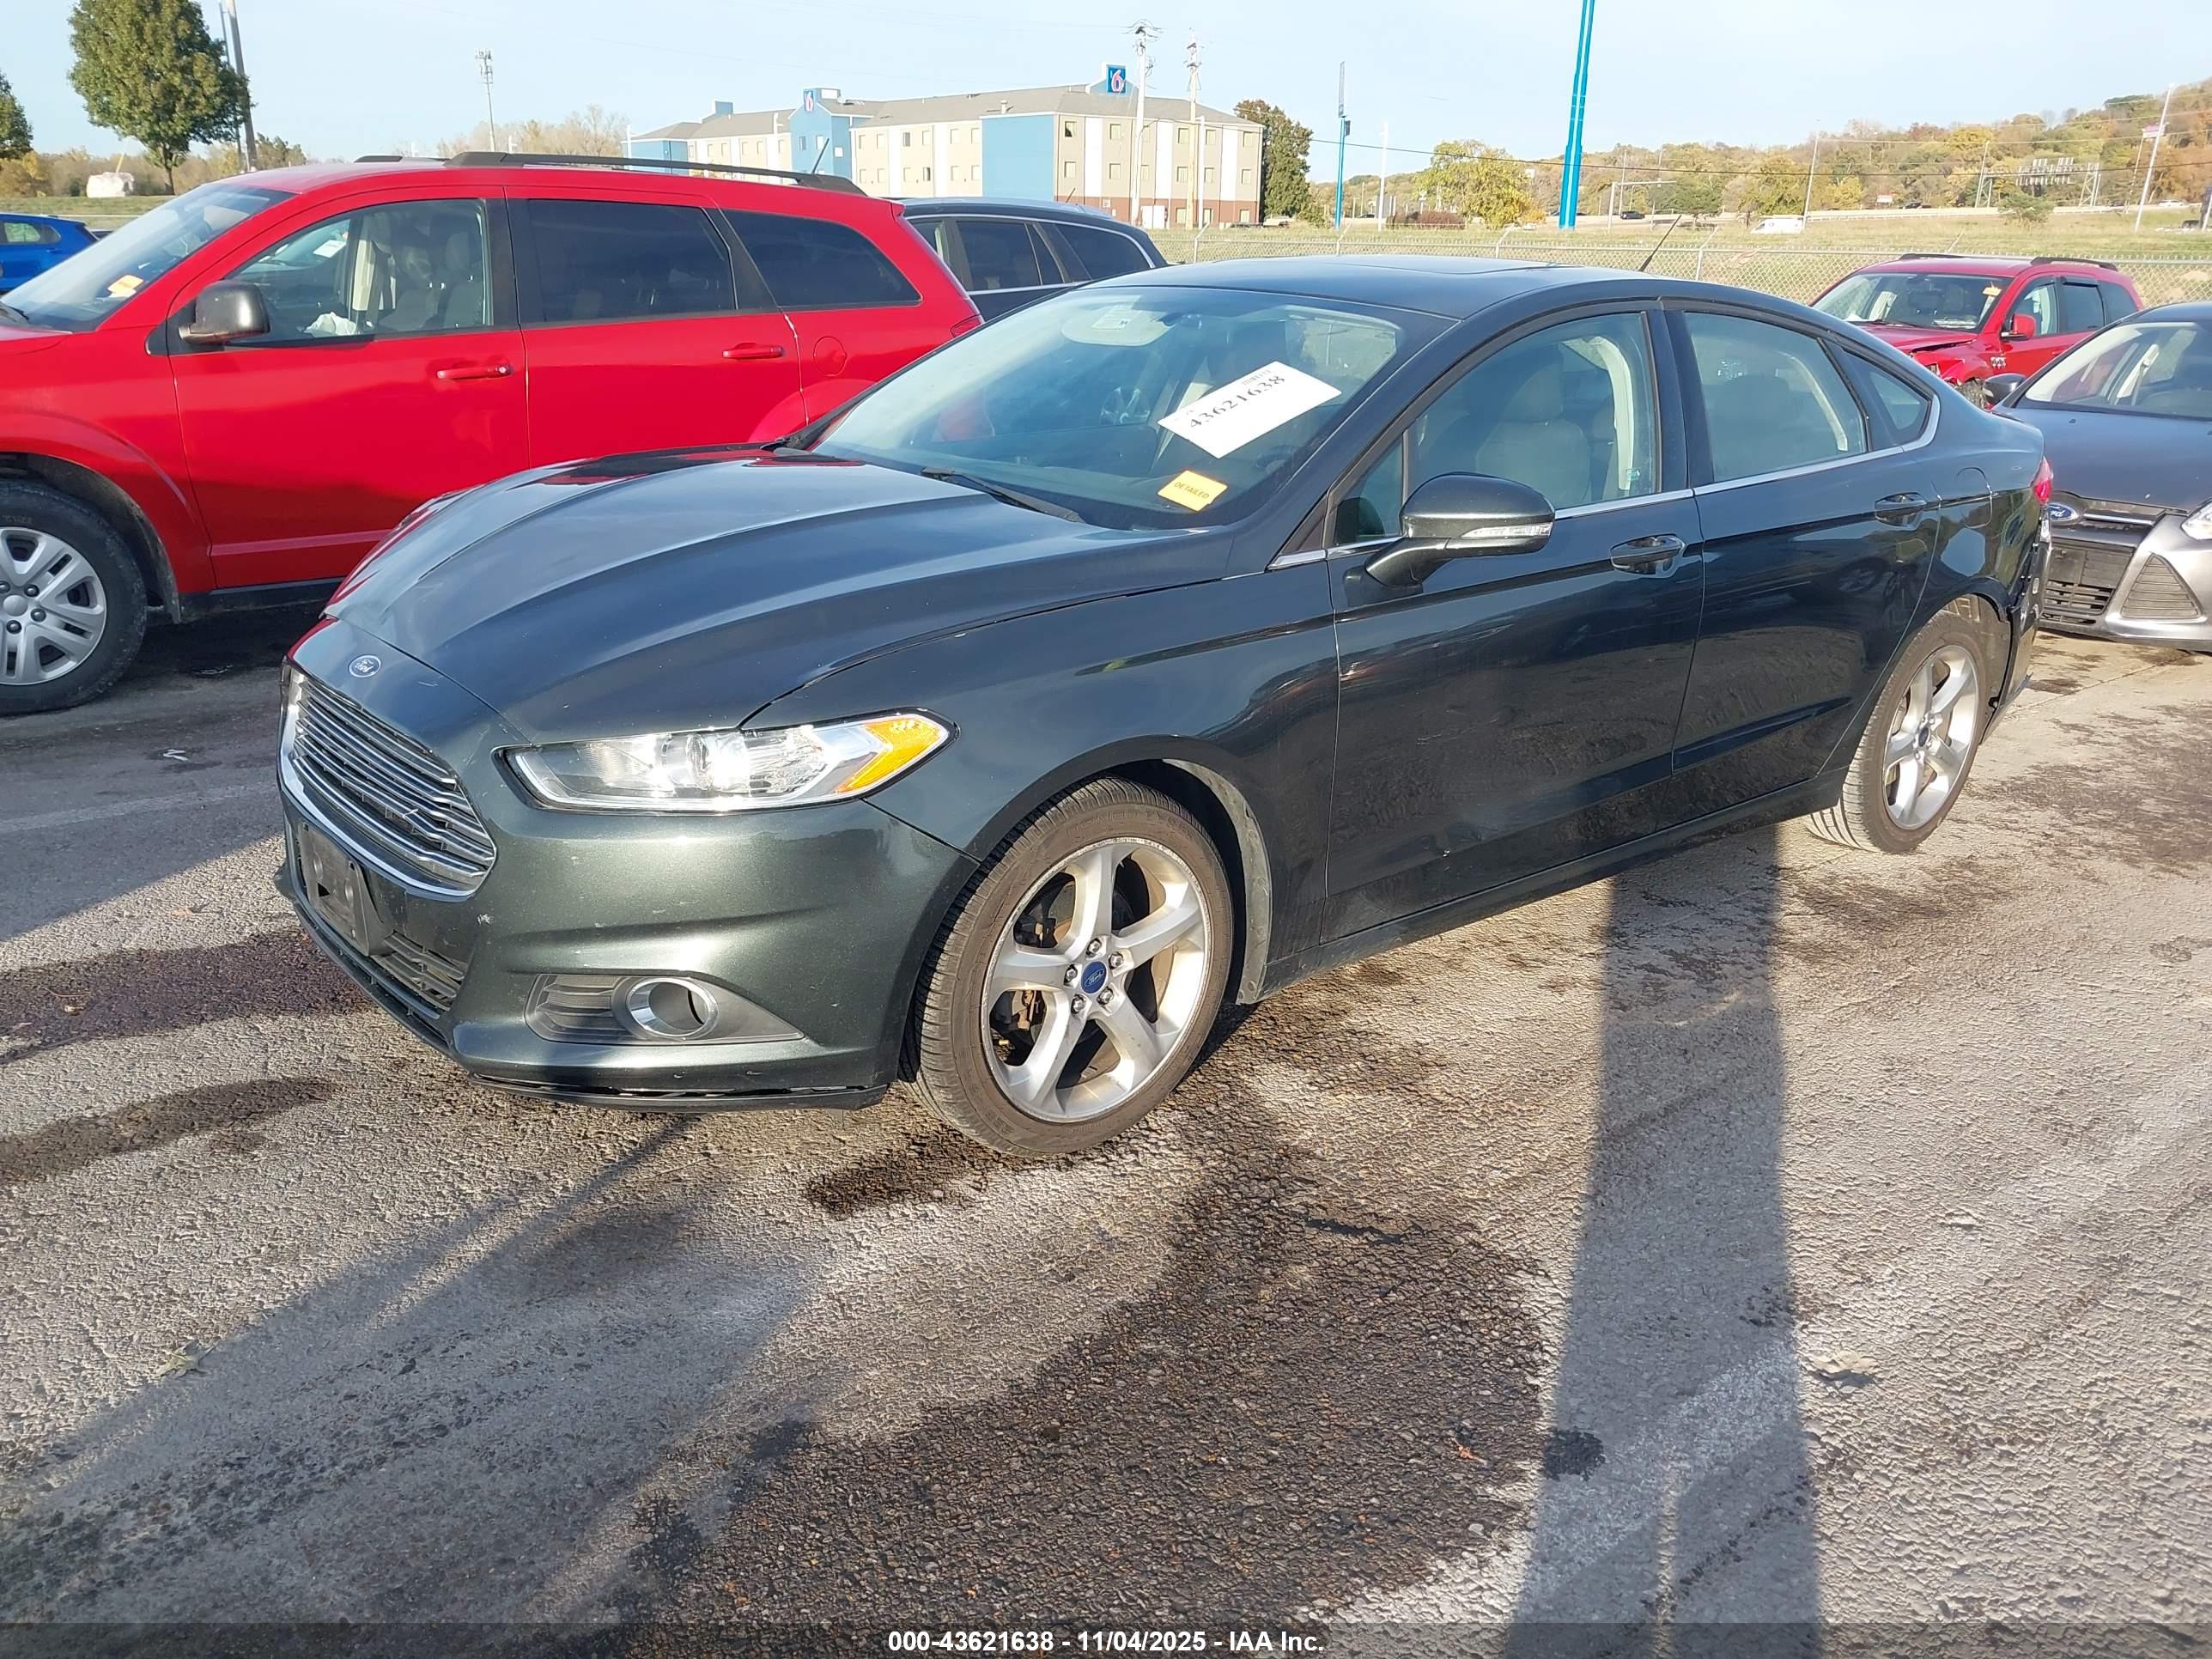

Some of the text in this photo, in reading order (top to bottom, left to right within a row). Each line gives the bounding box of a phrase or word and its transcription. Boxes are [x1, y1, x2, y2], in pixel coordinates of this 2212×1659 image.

[1111, 69, 1124, 93] 6
[1190, 375, 1285, 428] 43621638
[1173, 482, 1210, 500] DETAILED
